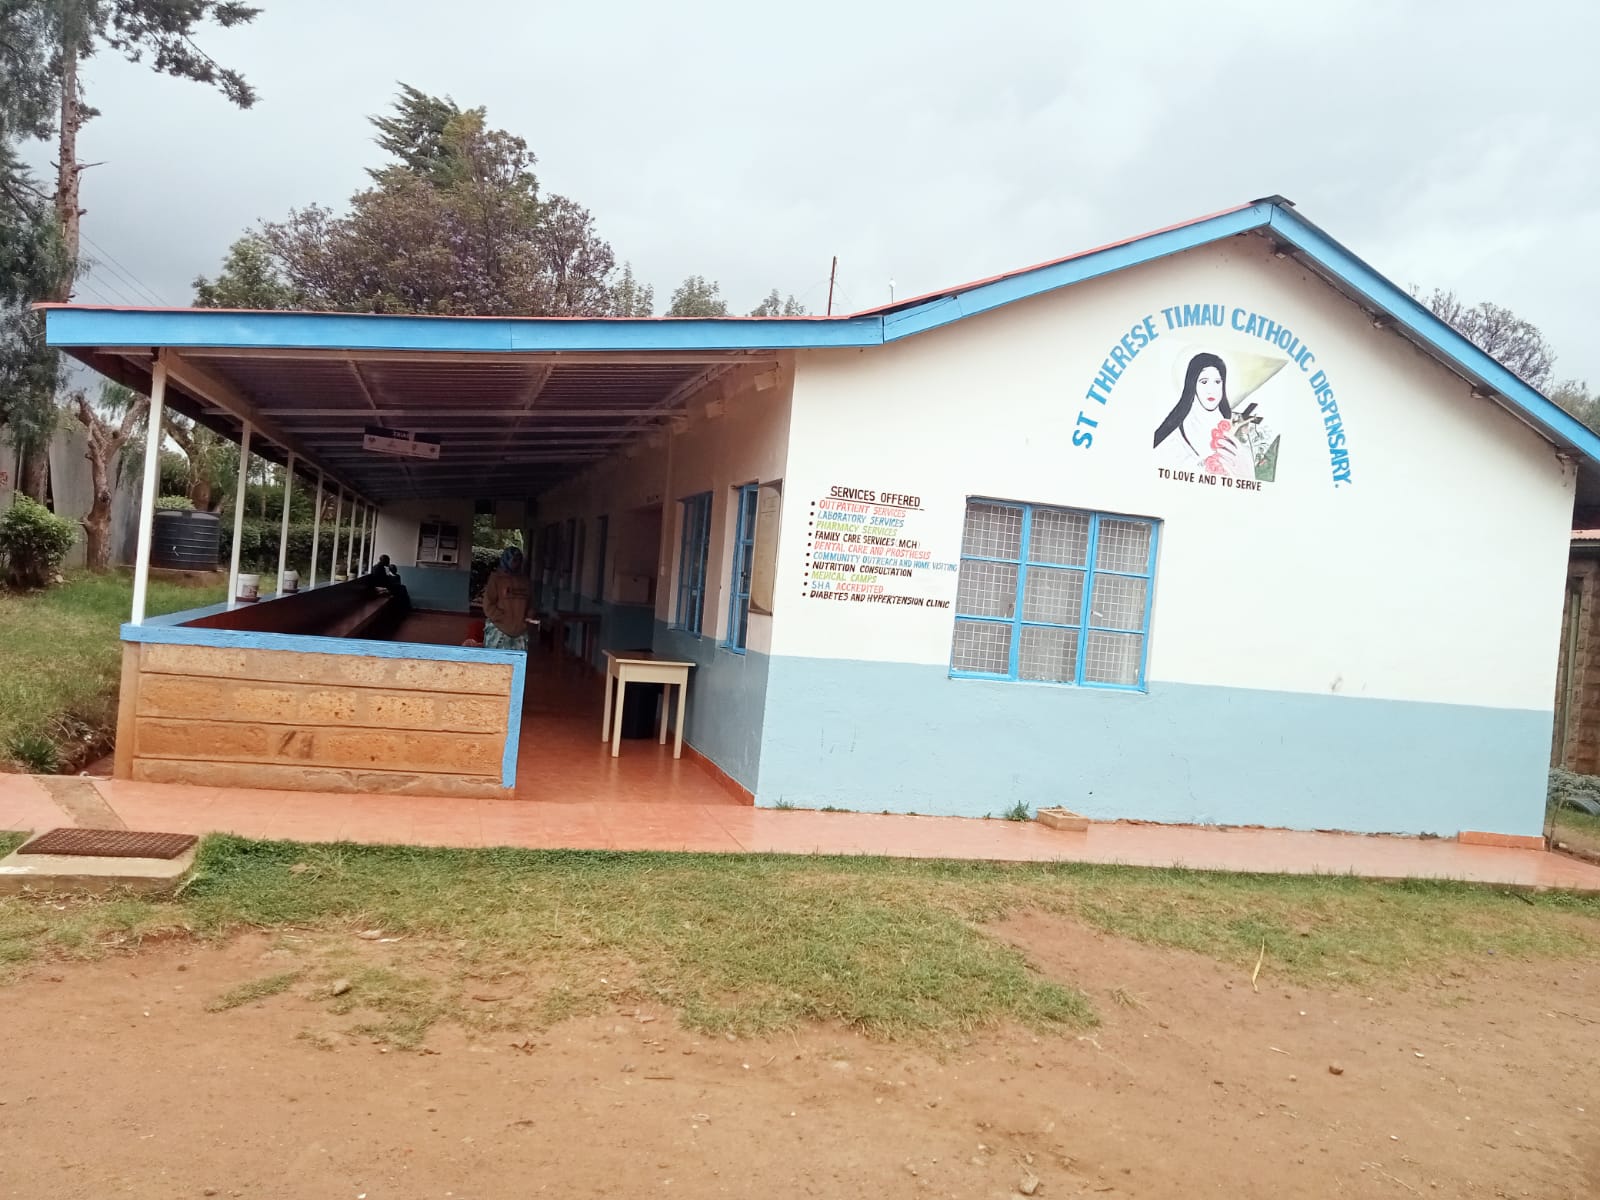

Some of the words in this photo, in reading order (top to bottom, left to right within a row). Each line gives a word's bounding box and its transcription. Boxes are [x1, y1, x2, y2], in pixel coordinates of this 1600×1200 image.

[1072, 411, 1098, 449] ST
[1086, 315, 1159, 405] THERESE
[1160, 304, 1225, 330] TIMAU
[1231, 307, 1315, 372] CATHOLIC
[1158, 468, 1171, 479] TO
[1173, 470, 1195, 483] LOVE
[1198, 474, 1216, 485] AND
[1221, 476, 1233, 487] TO
[1235, 479, 1262, 491] SERVE
[830, 486, 876, 501] SERVICES
[880, 492, 920, 507] OFFERED
[819, 500, 870, 513] OUTPATIENT
[873, 506, 906, 518] SERVICES
[818, 510, 866, 523] LABORATORY
[869, 516, 904, 527] SERVICES
[816, 520, 860, 532] PHARMACY
[862, 525, 897, 537] SERVICES
[815, 530, 840, 542] FAMILY
[842, 533, 861, 543] CARE
[863, 535, 895, 546] SERVICES
[814, 540, 844, 552] DENTAL
[847, 544, 868, 554] CARE
[870, 546, 884, 556] AND
[885, 548, 931, 560] PROSTHESIS
[812, 561, 855, 573] NUTRITION
[859, 564, 913, 577] CONSULTATION
[813, 551, 860, 563] COMMUNITY
[862, 555, 898, 566] OUTREACH
[899, 559, 913, 568] AND
[914, 560, 931, 569] HOME
[932, 562, 958, 572] VISITING
[811, 570, 846, 581] MEDICAL
[850, 573, 878, 583] CAMPS
[836, 582, 884, 594] ACCREDITED
[810, 590, 849, 601] DIABETES
[850, 593, 866, 602] AND
[867, 594, 924, 607] HYPERTENSION
[926, 598, 950, 609] CLINIC
